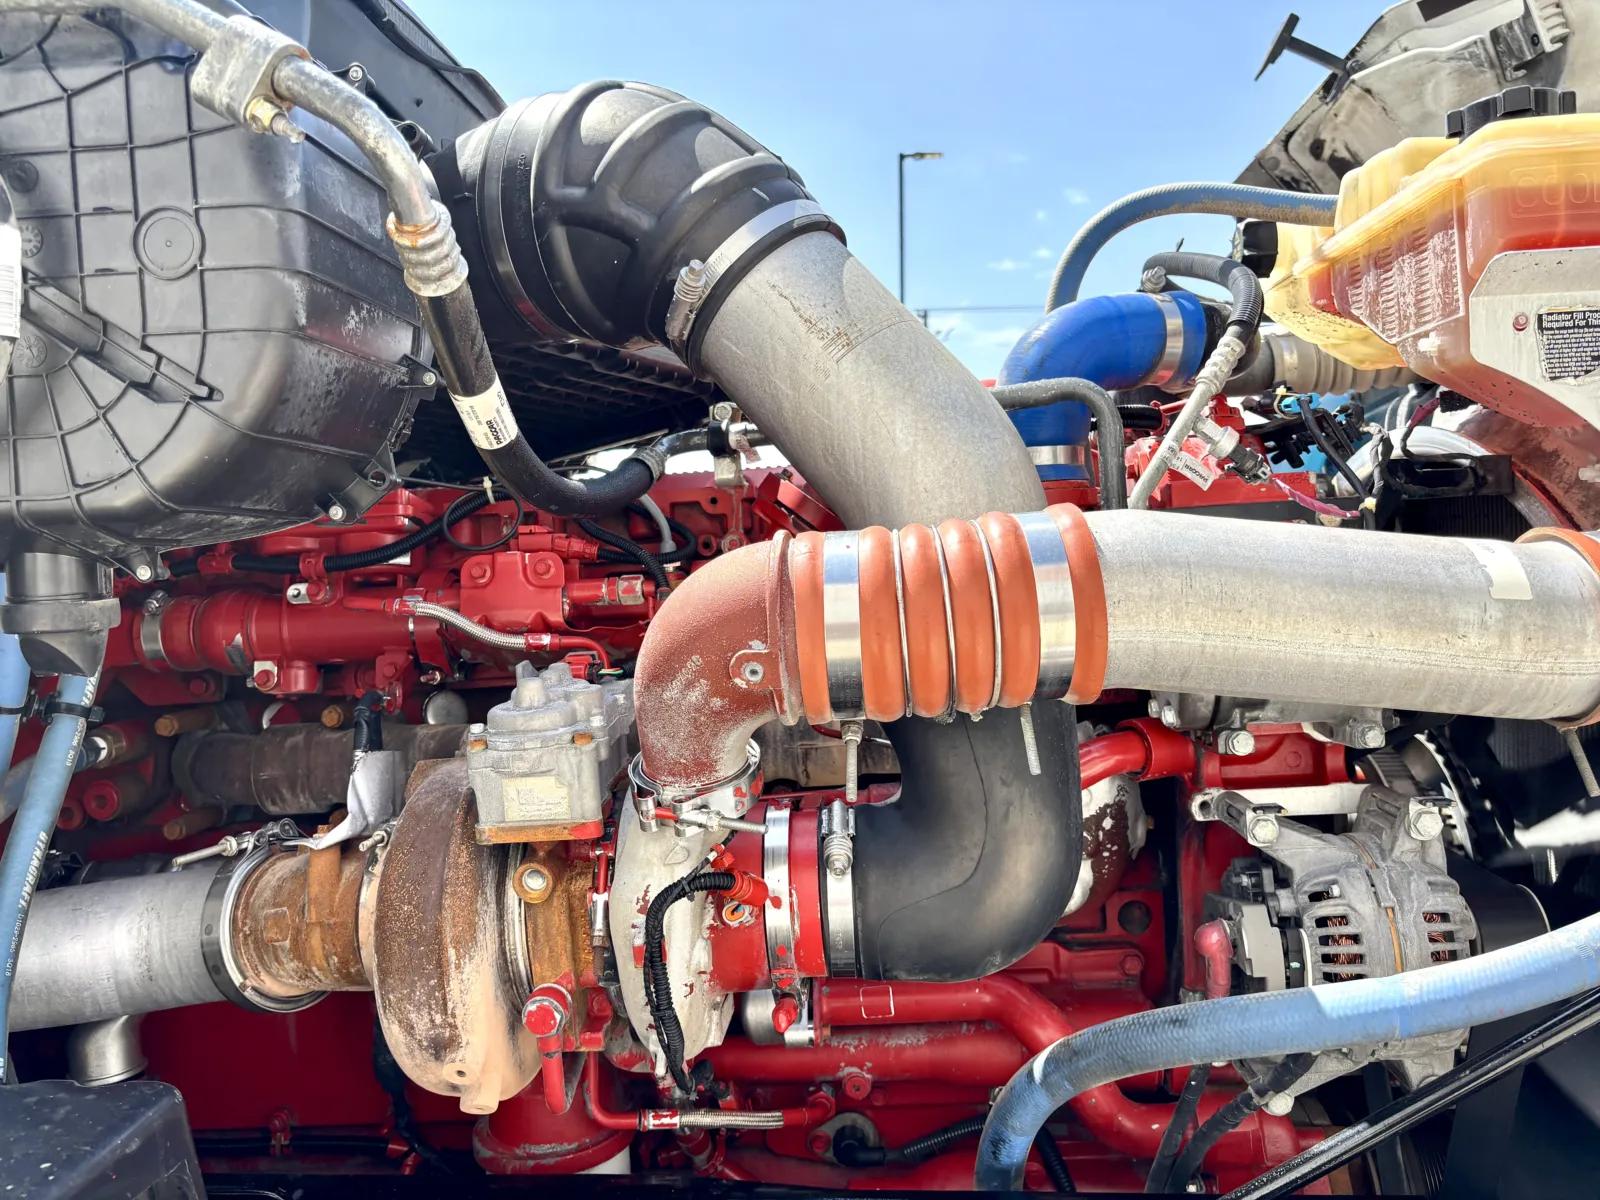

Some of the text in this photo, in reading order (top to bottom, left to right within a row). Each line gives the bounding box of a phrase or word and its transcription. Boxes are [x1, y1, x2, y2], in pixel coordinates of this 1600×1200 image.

[1543, 312, 1572, 322] Radiator
[1573, 312, 1584, 320] Fill
[1543, 320, 1573, 329] Required
[1575, 319, 1586, 327] For
[486, 419, 503, 445] PACCAR
